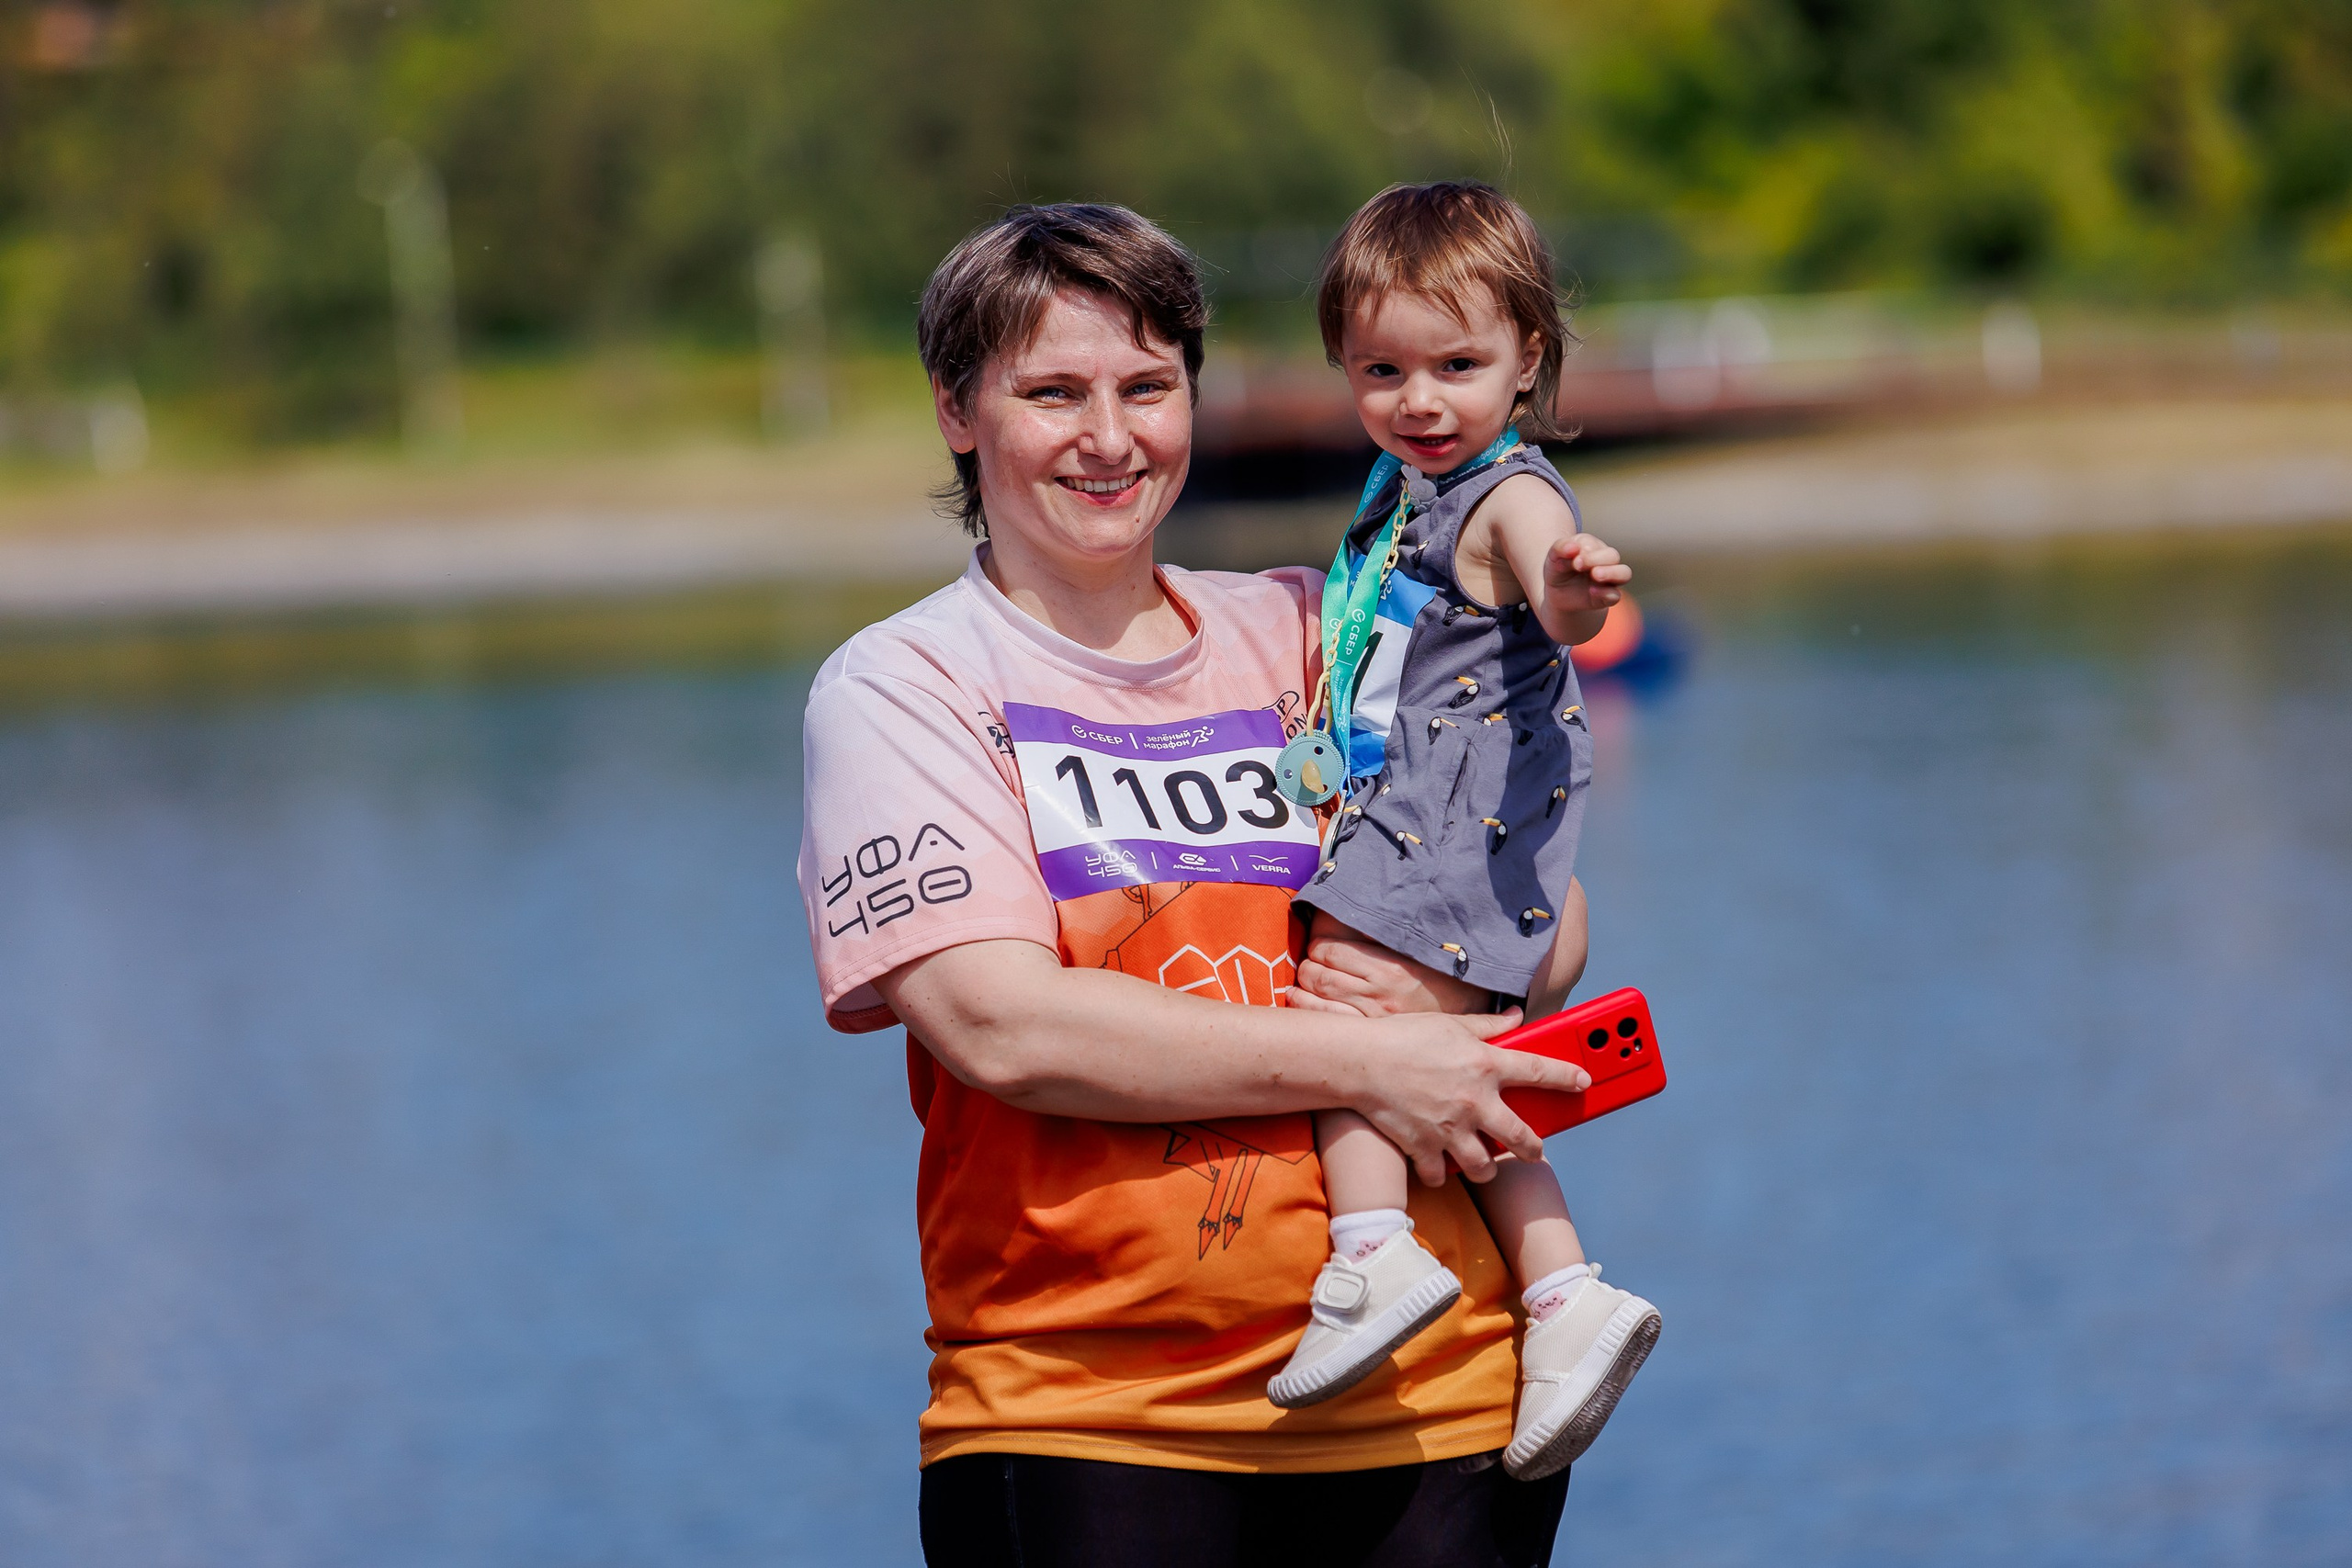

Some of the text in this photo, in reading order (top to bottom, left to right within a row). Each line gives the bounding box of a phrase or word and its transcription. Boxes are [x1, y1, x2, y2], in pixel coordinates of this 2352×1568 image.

[1371, 464, 1388, 489] СБЕР
[1344, 625, 1360, 656] СБЕР
[1089, 731, 1124, 745] СБЕР
[1146, 729, 1192, 742] зелёный
[1143, 739, 1191, 750] марафон
[1055, 754, 1290, 835] 1103
[1087, 862, 1138, 878] 450
[1251, 864, 1292, 874] VERRA
[828, 864, 972, 938] 450
